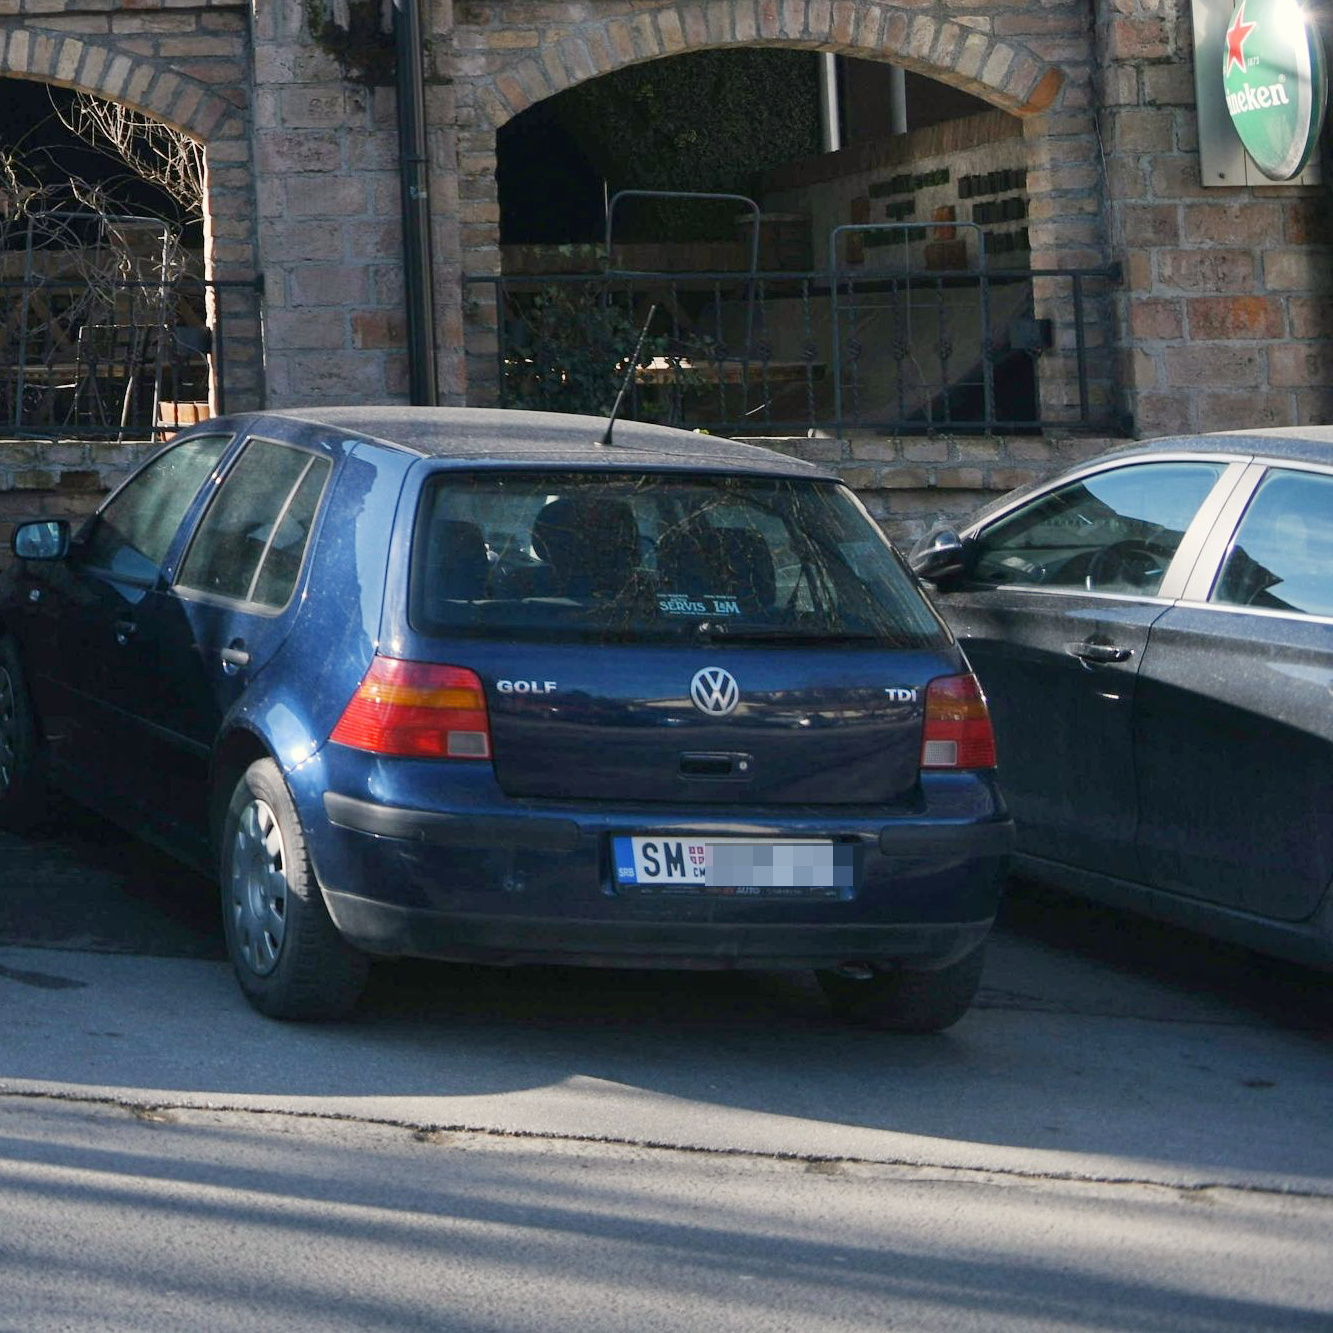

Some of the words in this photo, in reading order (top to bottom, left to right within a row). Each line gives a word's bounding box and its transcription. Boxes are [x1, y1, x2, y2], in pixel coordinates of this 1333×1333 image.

[659, 600, 706, 612] SERVIS
[496, 679, 557, 695] GOLF
[885, 688, 918, 702] TDI
[642, 842, 686, 877] SM
[618, 867, 635, 877] SRB
